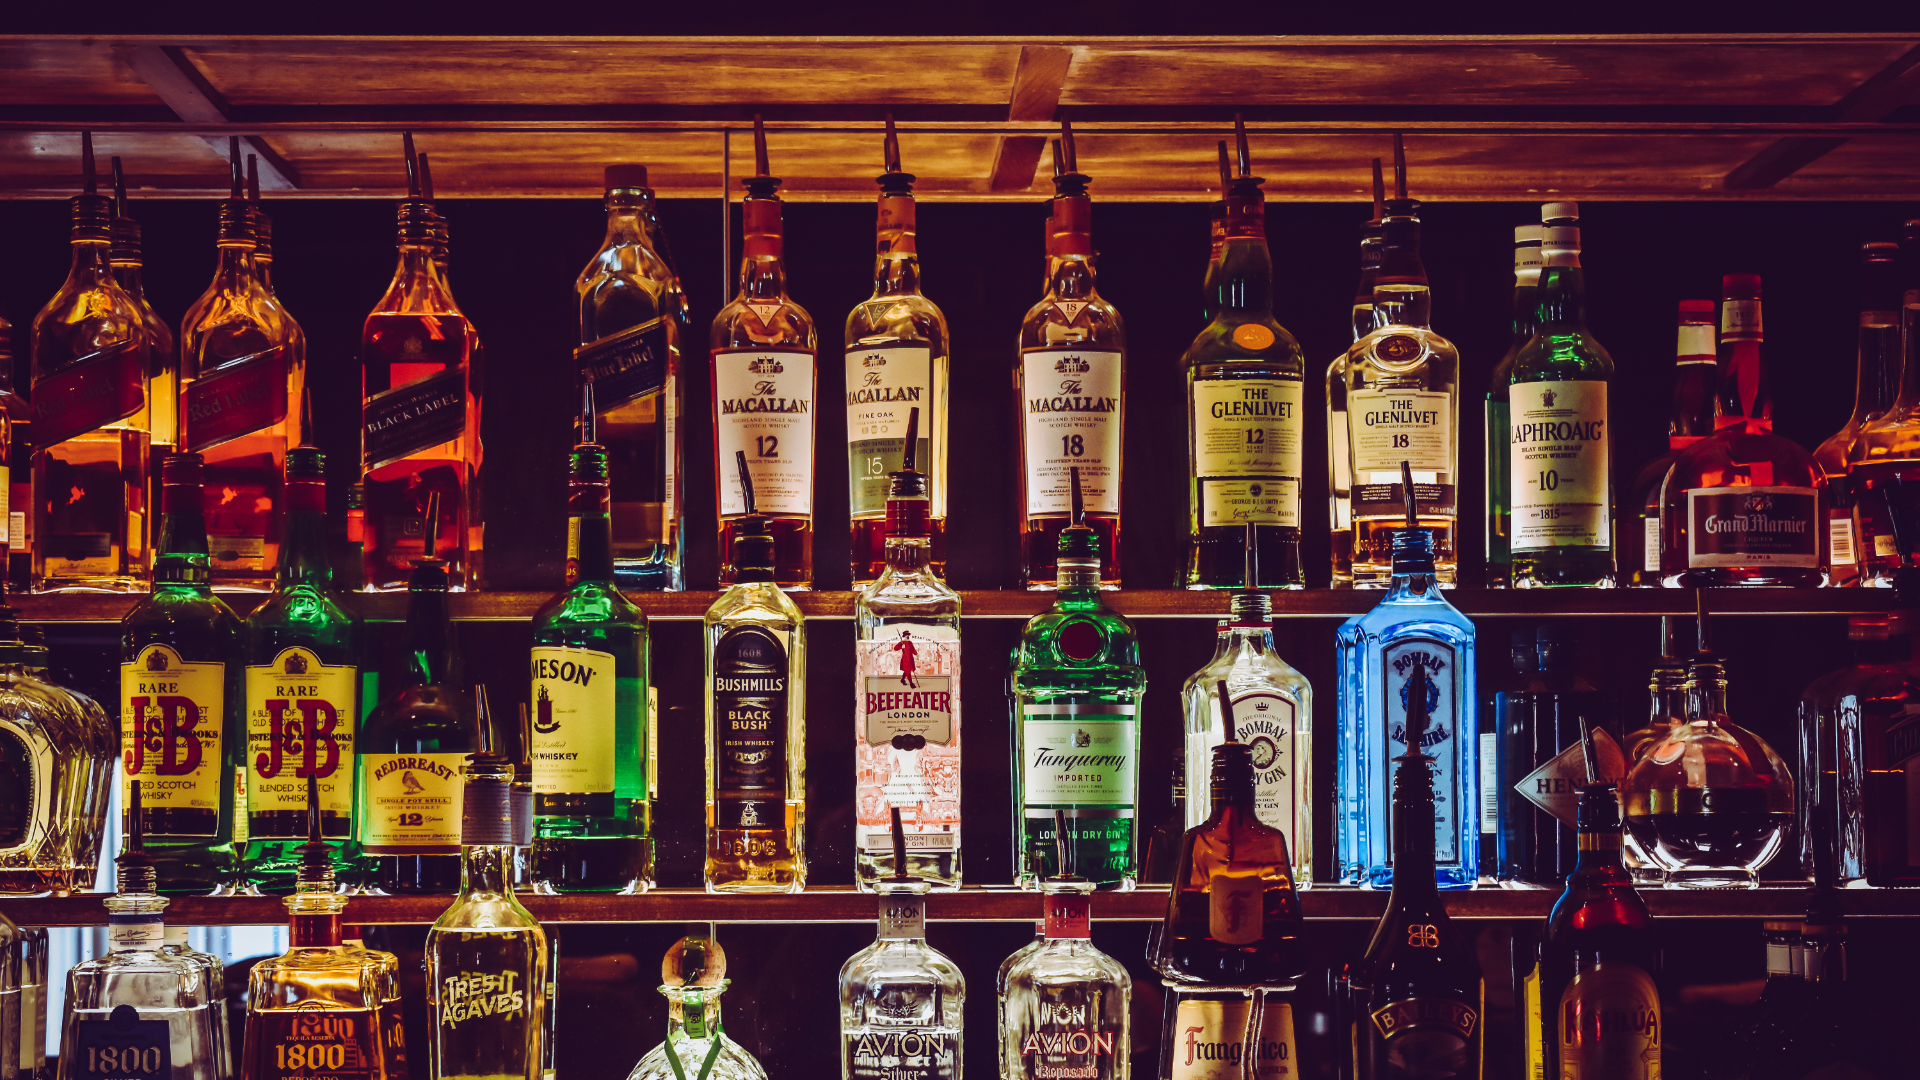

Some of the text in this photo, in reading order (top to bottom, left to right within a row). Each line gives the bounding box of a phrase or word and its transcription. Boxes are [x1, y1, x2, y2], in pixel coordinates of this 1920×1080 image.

[759, 305, 771, 315] 12
[874, 304, 886, 313] 15
[1065, 303, 1077, 312] 18
[862, 371, 883, 388] The
[1058, 379, 1083, 396] The
[752, 380, 777, 397] The
[1241, 388, 1269, 400] THE
[722, 397, 810, 416] MACALLAN
[1029, 396, 1118, 414] MACALLAN
[1211, 401, 1293, 419] GLENLIVET
[1389, 399, 1413, 410] THE
[367, 393, 459, 434] BLACK LABEL
[858, 411, 894, 420] FINE OAK
[1365, 410, 1439, 426] GLENLIVET
[1245, 428, 1265, 444] 12
[1511, 420, 1603, 444] LAPHROAIG
[755, 435, 779, 458] 12
[1061, 434, 1085, 458] 18
[1391, 433, 1410, 449] 18
[867, 457, 884, 475] 15
[1539, 469, 1559, 491] 10
[1540, 508, 1560, 520] 1815
[1705, 513, 1807, 534] Grand Marnier
[738, 649, 762, 658] 1608
[1392, 651, 1447, 676] BOMBAY
[139, 682, 179, 694] RARE
[276, 685, 319, 697] RARE
[716, 677, 784, 692] BUSHMILLS
[865, 691, 952, 715] BEEFEATER
[253, 718, 267, 727] OLD
[728, 710, 771, 720] BLACK
[887, 711, 930, 719] LONDON
[732, 720, 768, 730] BUSH
[1237, 720, 1288, 742] BOMBAY
[540, 752, 578, 760] WHISKEY
[1034, 747, 1127, 772] Tanqueray
[374, 757, 455, 781] REDBREAST
[1264, 765, 1287, 785] GIN
[156, 781, 196, 790] SCOTCH
[1054, 774, 1102, 782] IMPORTED
[140, 791, 173, 800] WHISKY
[259, 783, 335, 793] BLENDED SCTCH
[1255, 789, 1279, 797] istilled
[277, 794, 309, 803] WHISK
[398, 812, 424, 827] 12
[1082, 830, 1102, 840] DRY
[1106, 830, 1121, 840] GIN
[444, 974, 496, 1008] TRES
[441, 990, 524, 1030] AGAVES
[1380, 1002, 1474, 1029] BAILEYS
[1562, 998, 1659, 1047] KAHLÚA
[855, 1029, 946, 1058] AVIÓN
[1022, 1027, 1115, 1057] AVIÓN
[1184, 1026, 1289, 1067] Frangico
[87, 1045, 162, 1074] 1800
[275, 1043, 345, 1070] 1800
[1036, 1064, 1099, 1080] Reposado
